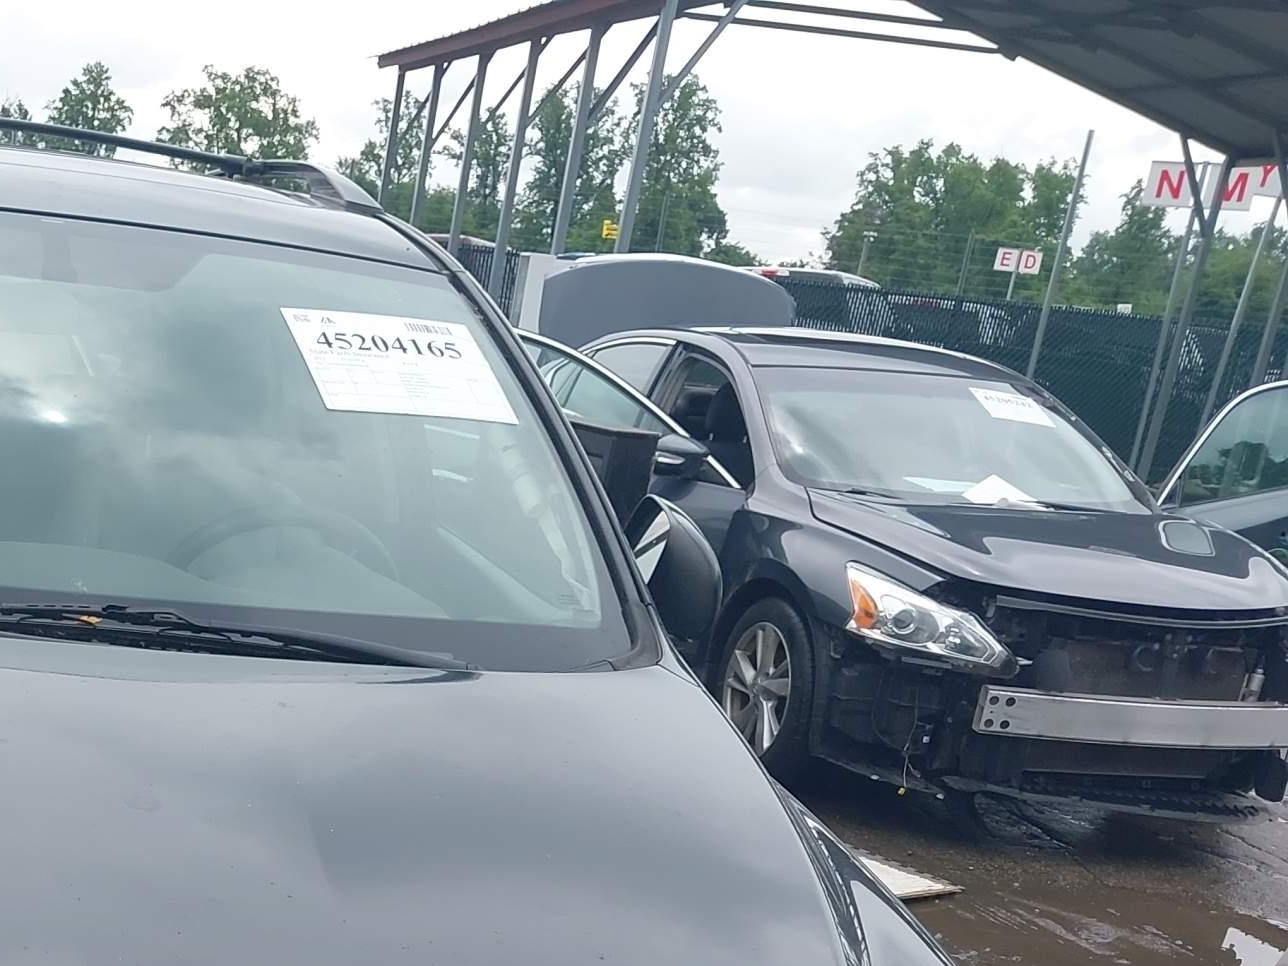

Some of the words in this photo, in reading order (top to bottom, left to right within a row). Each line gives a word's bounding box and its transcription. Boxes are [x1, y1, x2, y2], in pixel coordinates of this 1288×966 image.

[1155, 169, 1186, 200] N
[1222, 172, 1250, 202] M
[999, 252, 1012, 267] E
[1024, 254, 1037, 270] D
[316, 331, 463, 360] 45204165
